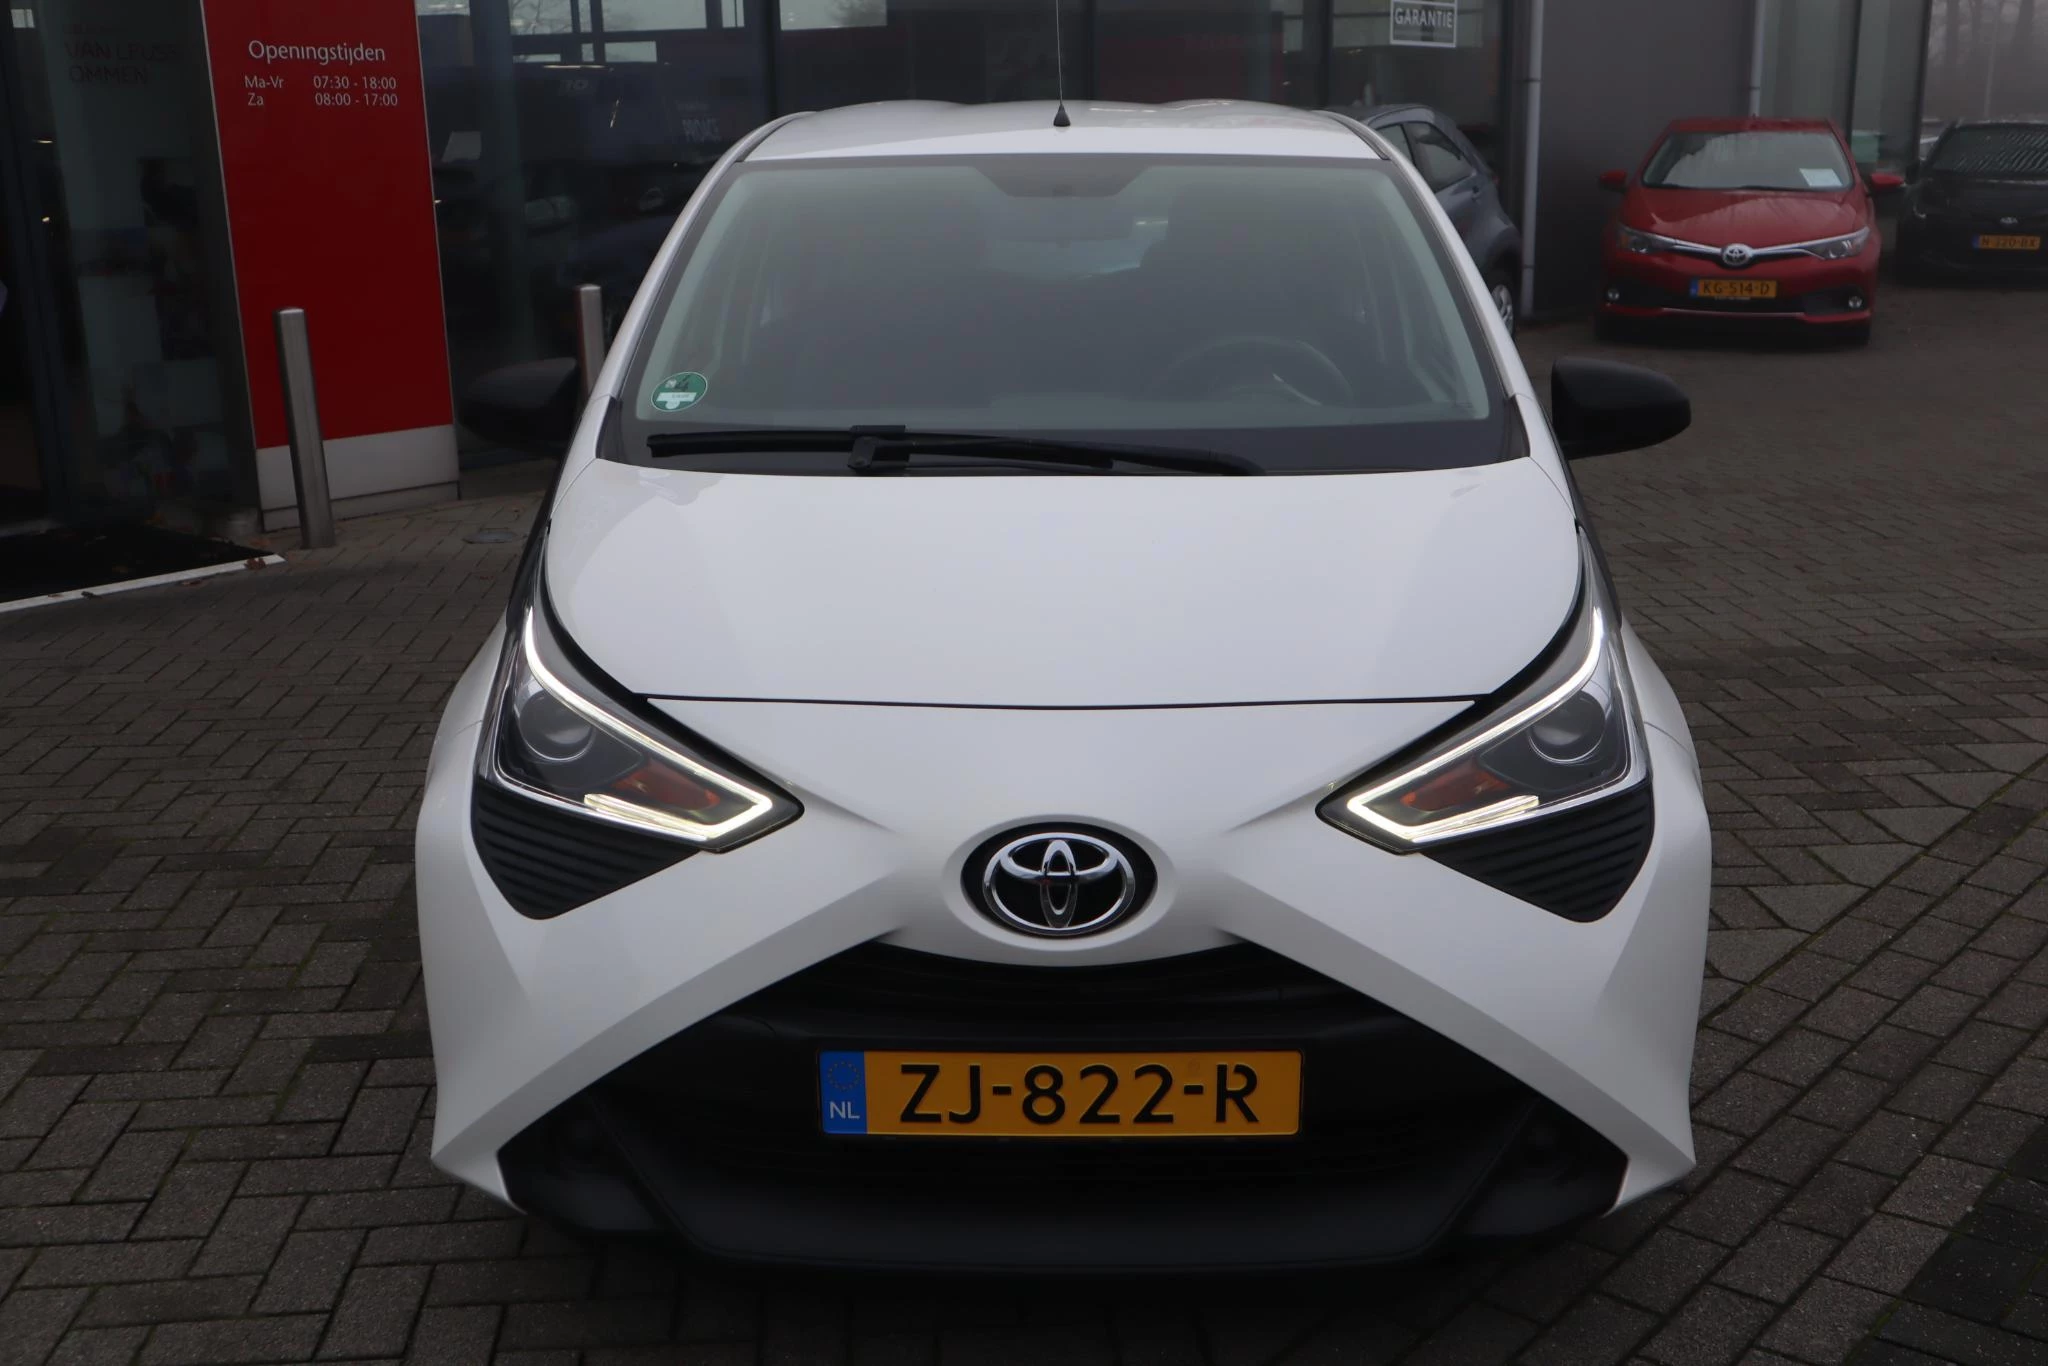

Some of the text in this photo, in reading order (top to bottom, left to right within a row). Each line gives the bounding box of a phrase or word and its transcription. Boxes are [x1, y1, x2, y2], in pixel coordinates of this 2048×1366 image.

[1394, 8, 1454, 28] GARANTIE
[248, 40, 386, 66] Openingstijden
[244, 75, 284, 89] Ma-Vr
[313, 75, 349, 89] 07:30
[363, 76, 397, 90] 18:00
[247, 92, 264, 106] Za
[315, 93, 351, 106] 08:00
[364, 93, 398, 107] 17:00
[1703, 281, 1769, 296] KG-514-D
[829, 1063, 1260, 1124] NL ZJ-822-R
